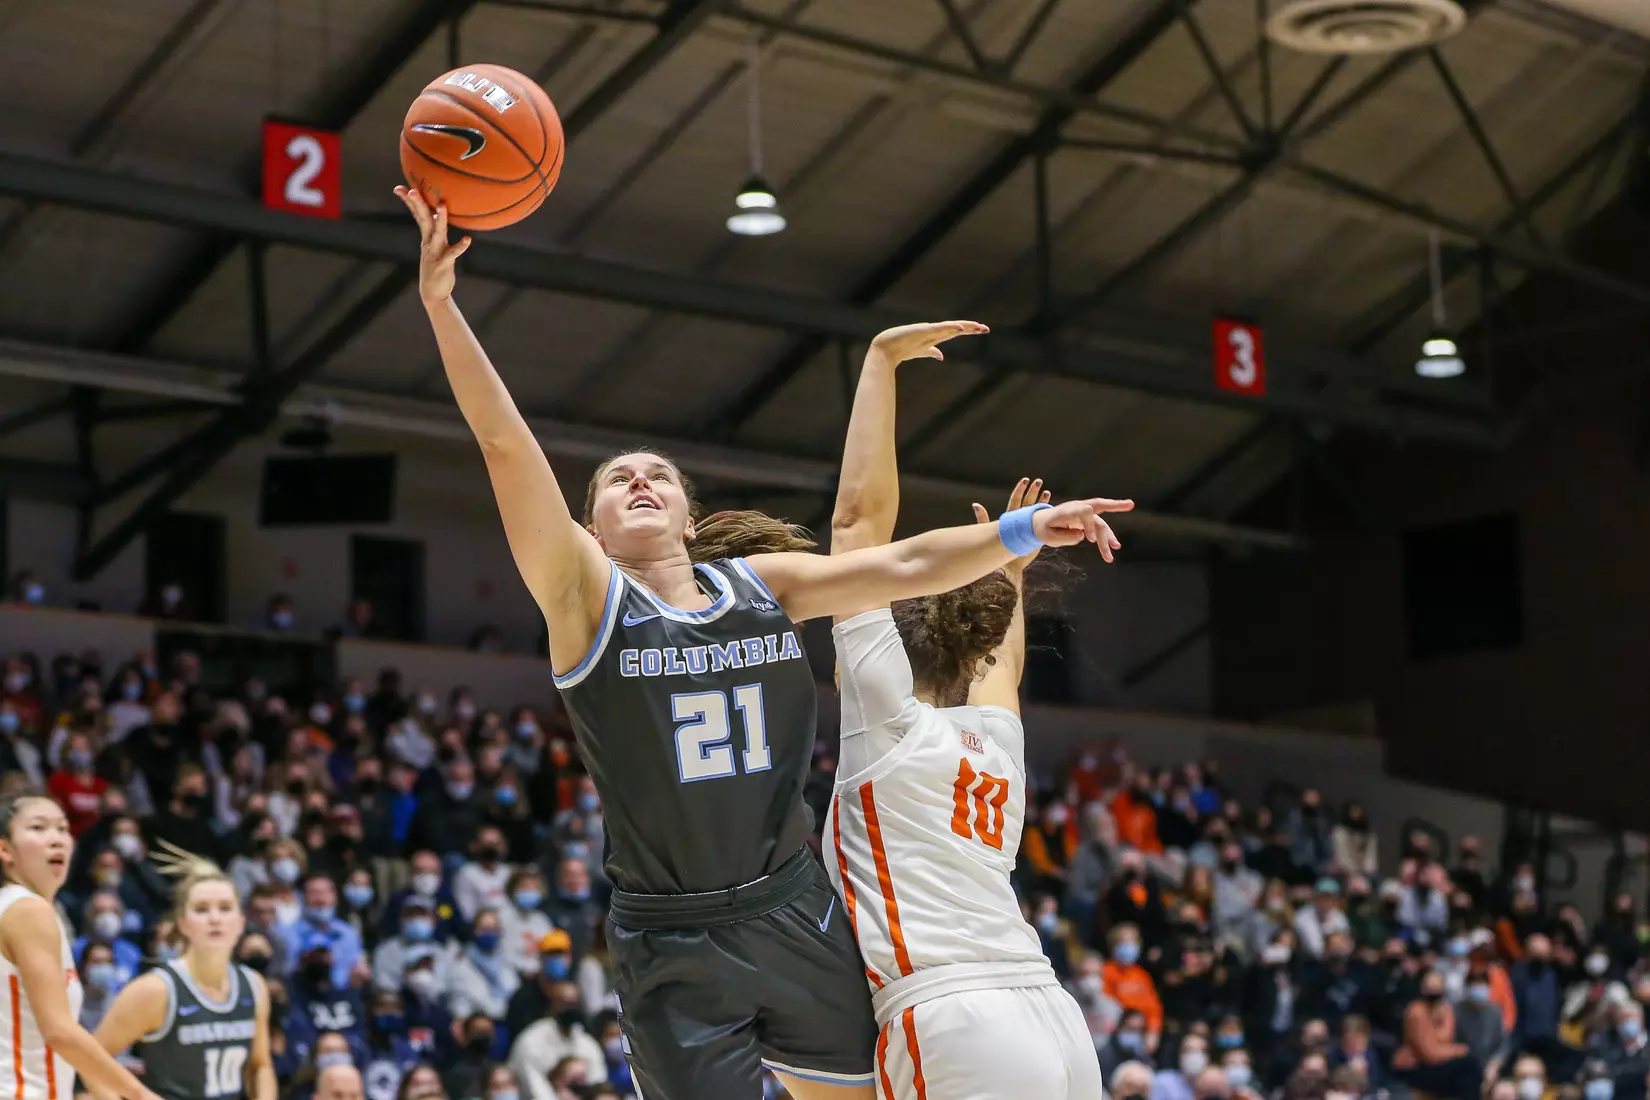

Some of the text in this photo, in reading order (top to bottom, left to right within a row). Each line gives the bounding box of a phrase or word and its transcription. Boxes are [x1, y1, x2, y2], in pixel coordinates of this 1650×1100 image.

[285, 135, 324, 206] 2
[1229, 327, 1256, 386] 3
[620, 631, 802, 677] COLUMBIA
[671, 682, 772, 783] 21
[950, 757, 1009, 851] 10
[204, 1045, 248, 1097] 10
